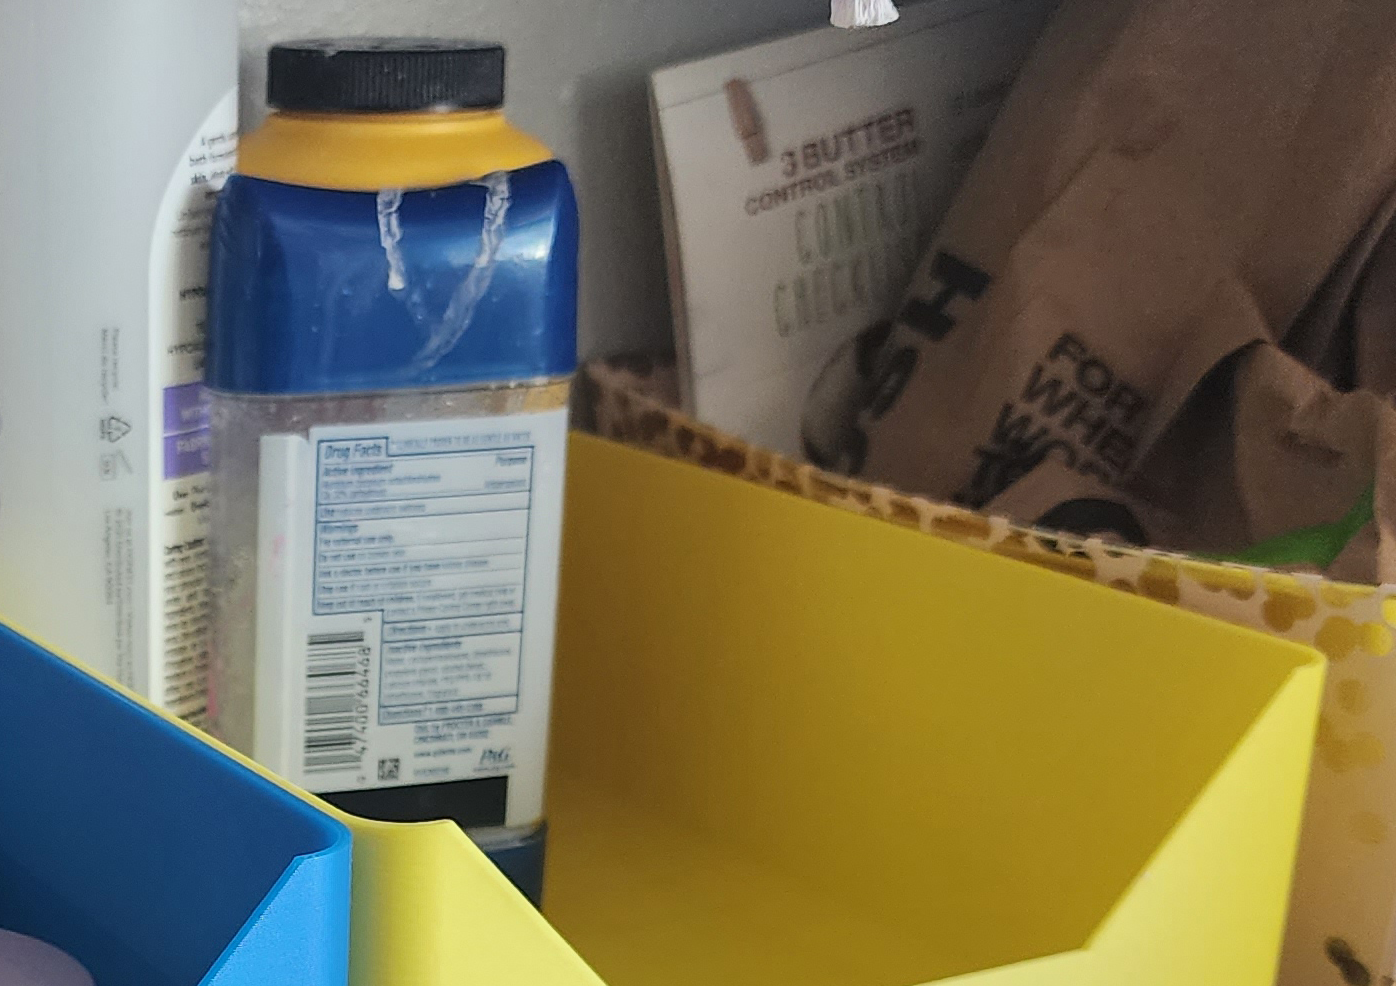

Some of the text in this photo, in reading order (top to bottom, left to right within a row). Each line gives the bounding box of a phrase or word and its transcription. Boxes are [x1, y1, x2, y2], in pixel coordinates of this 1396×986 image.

[801, 107, 916, 169] BUTTER
[743, 136, 923, 217] CONTROL SYSTEM
[323, 443, 383, 460] Drug Facts
